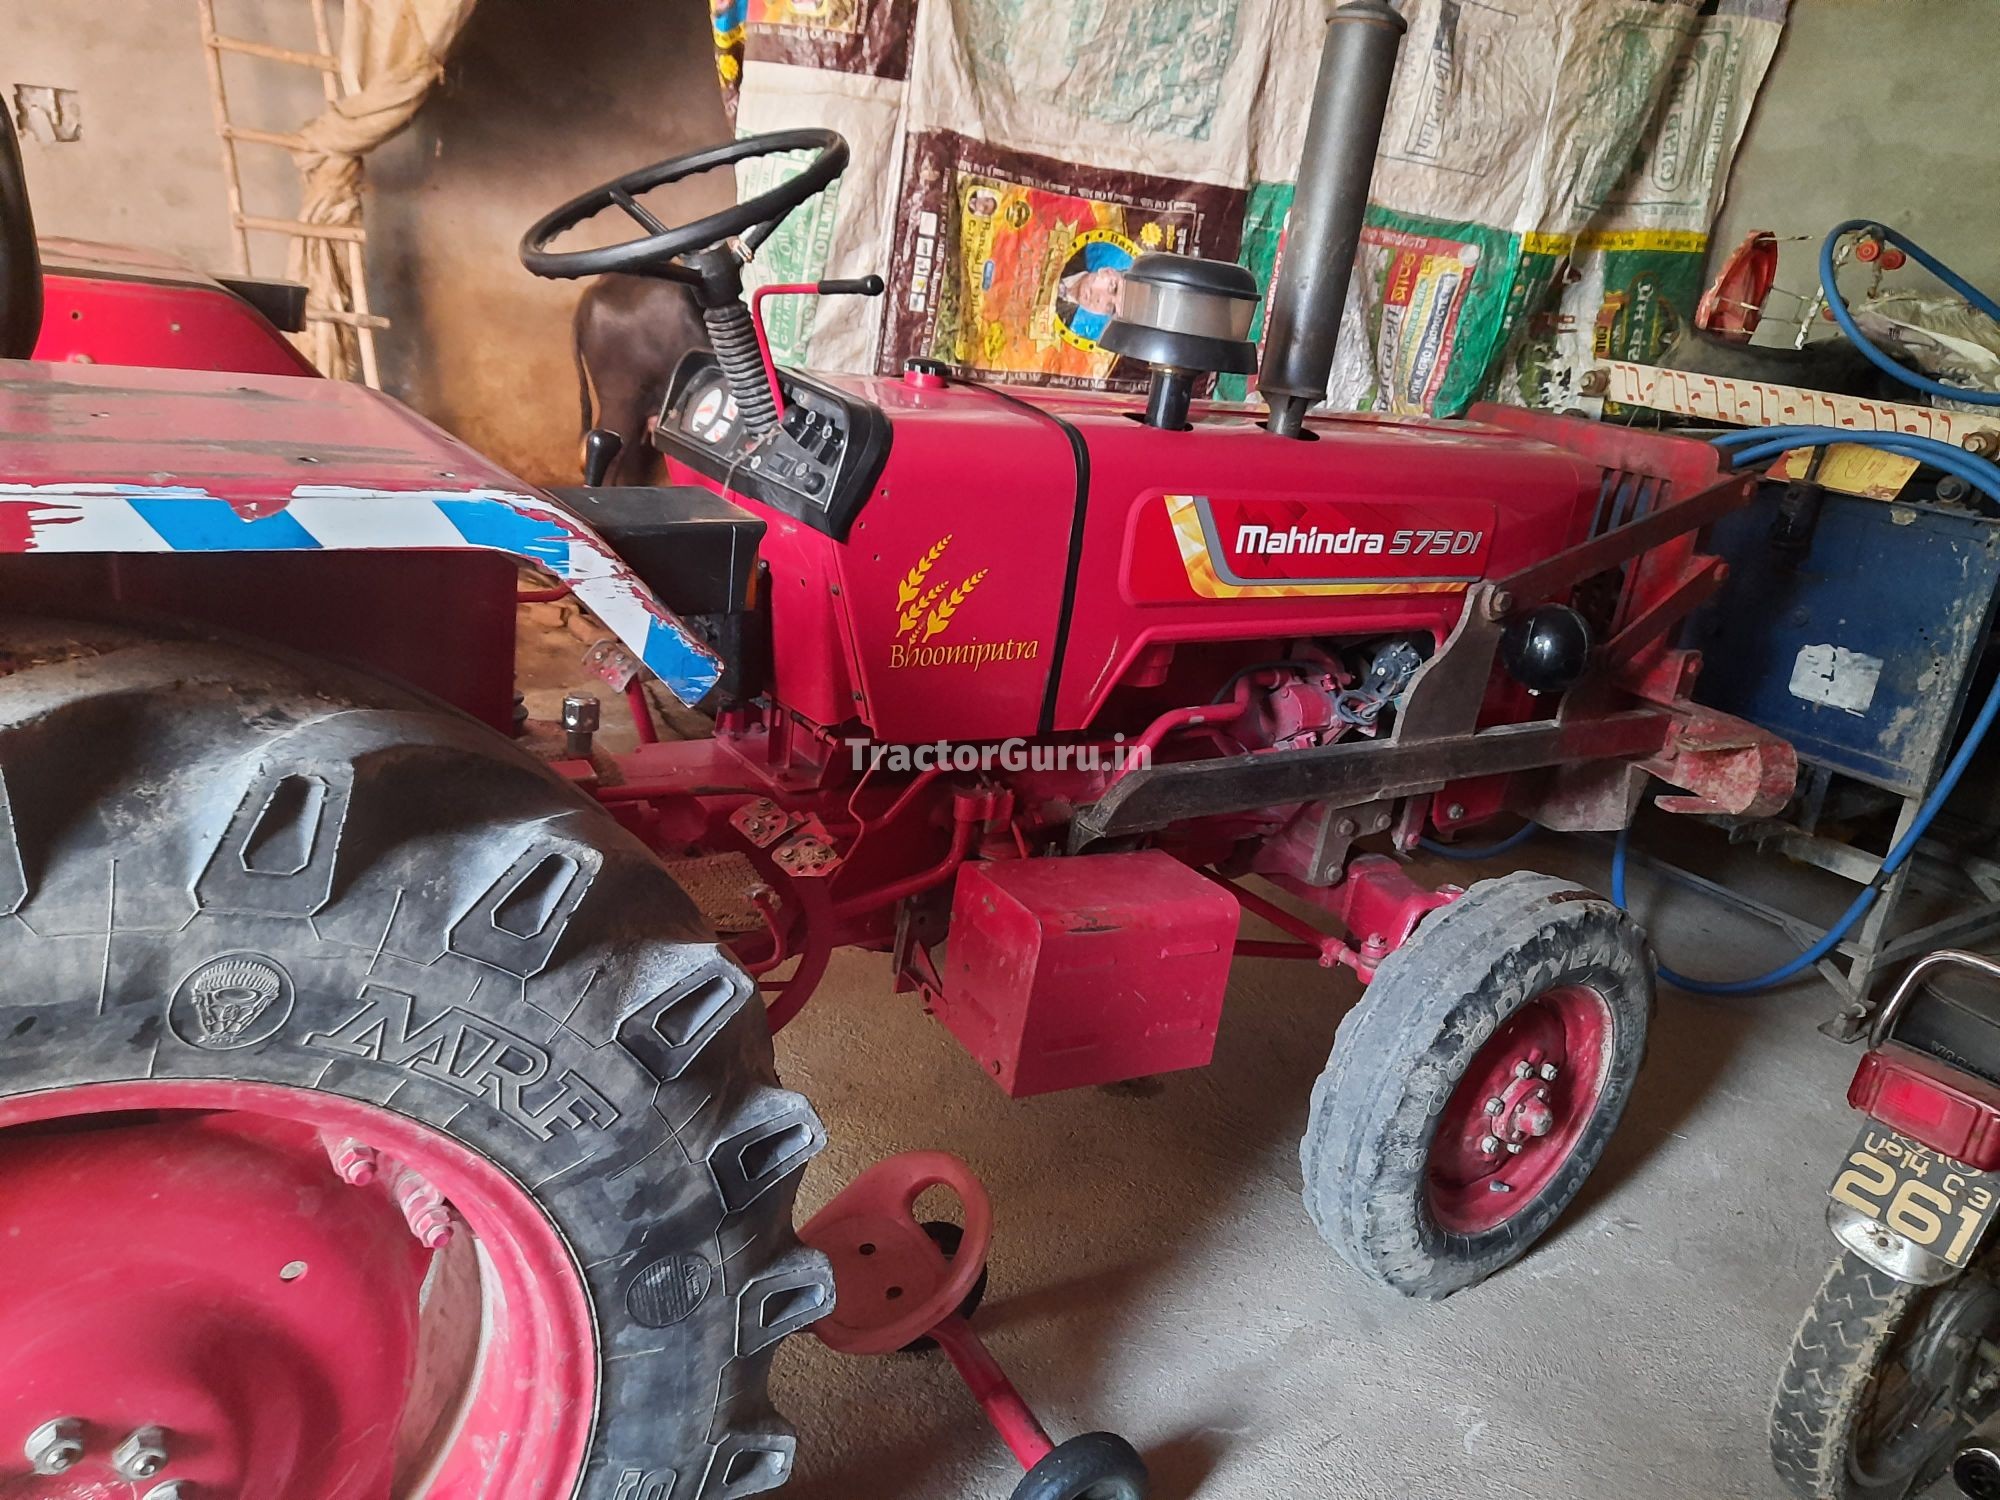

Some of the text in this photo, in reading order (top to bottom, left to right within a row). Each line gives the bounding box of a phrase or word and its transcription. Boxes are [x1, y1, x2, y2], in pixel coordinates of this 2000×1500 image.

[1415, 350, 1432, 377] AGRO
[1235, 524, 1383, 555] Mahindra
[888, 636, 1039, 671] Bhoomiputra
[302, 983, 620, 1141] MRF
[1830, 1146, 1983, 1264] 261
